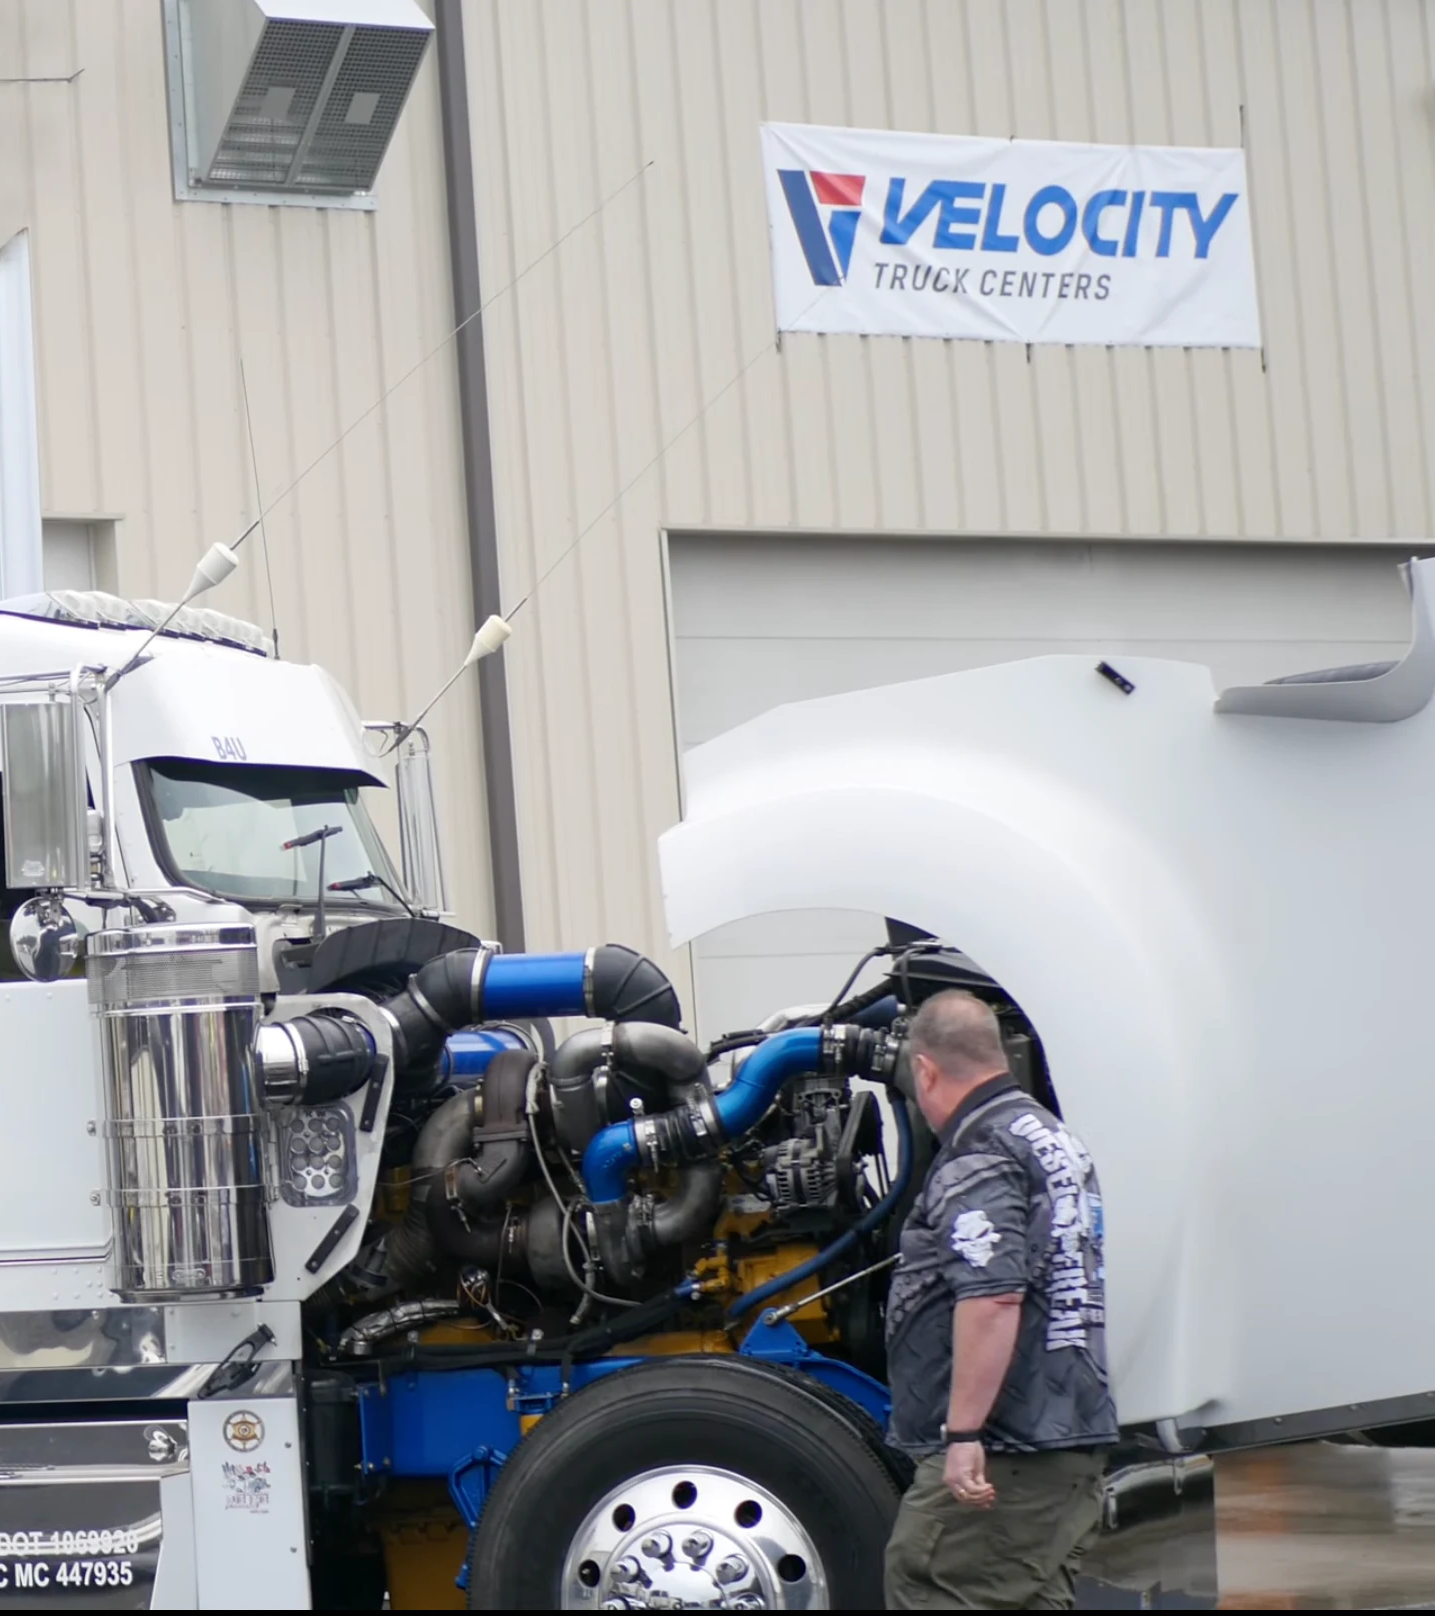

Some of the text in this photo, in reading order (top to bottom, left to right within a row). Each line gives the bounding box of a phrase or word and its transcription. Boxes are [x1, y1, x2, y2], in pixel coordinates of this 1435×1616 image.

[879, 177, 1239, 259] VELOCITY
[873, 263, 1111, 300] TRUCK CENTERS
[211, 736, 248, 762] B4U
[15, 1562, 50, 1588] MC
[56, 1561, 133, 1587] 447935
